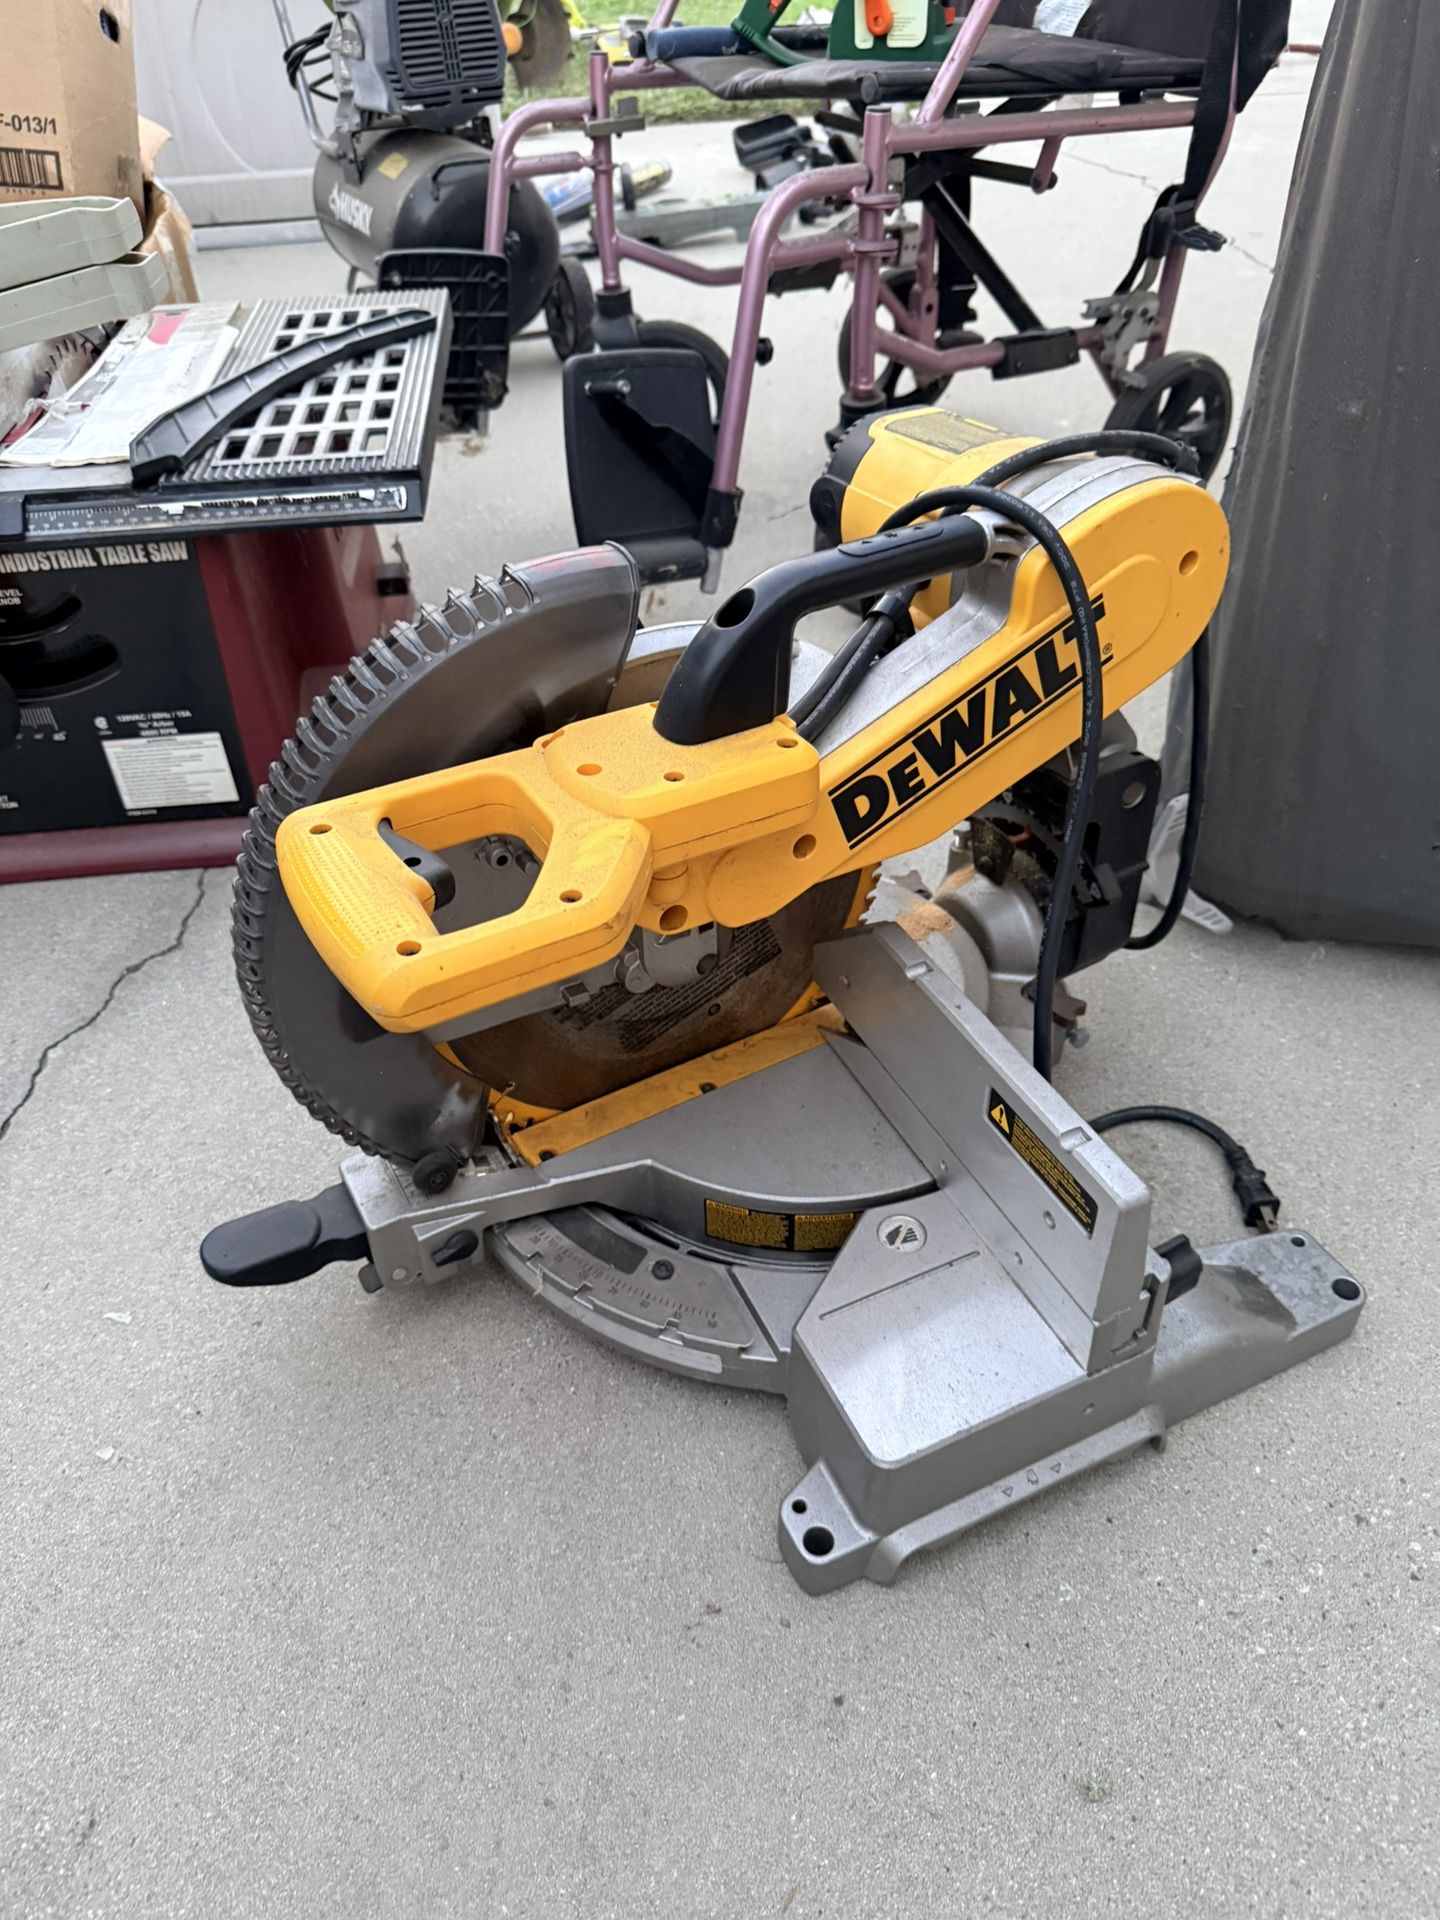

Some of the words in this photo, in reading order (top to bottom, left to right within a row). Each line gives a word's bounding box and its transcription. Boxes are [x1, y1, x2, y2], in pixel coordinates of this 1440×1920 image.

[339, 190, 374, 236] HUSKY
[0, 548, 97, 574] INDUSTRIAL
[96, 544, 149, 567] TABLE
[147, 541, 189, 563] SAW
